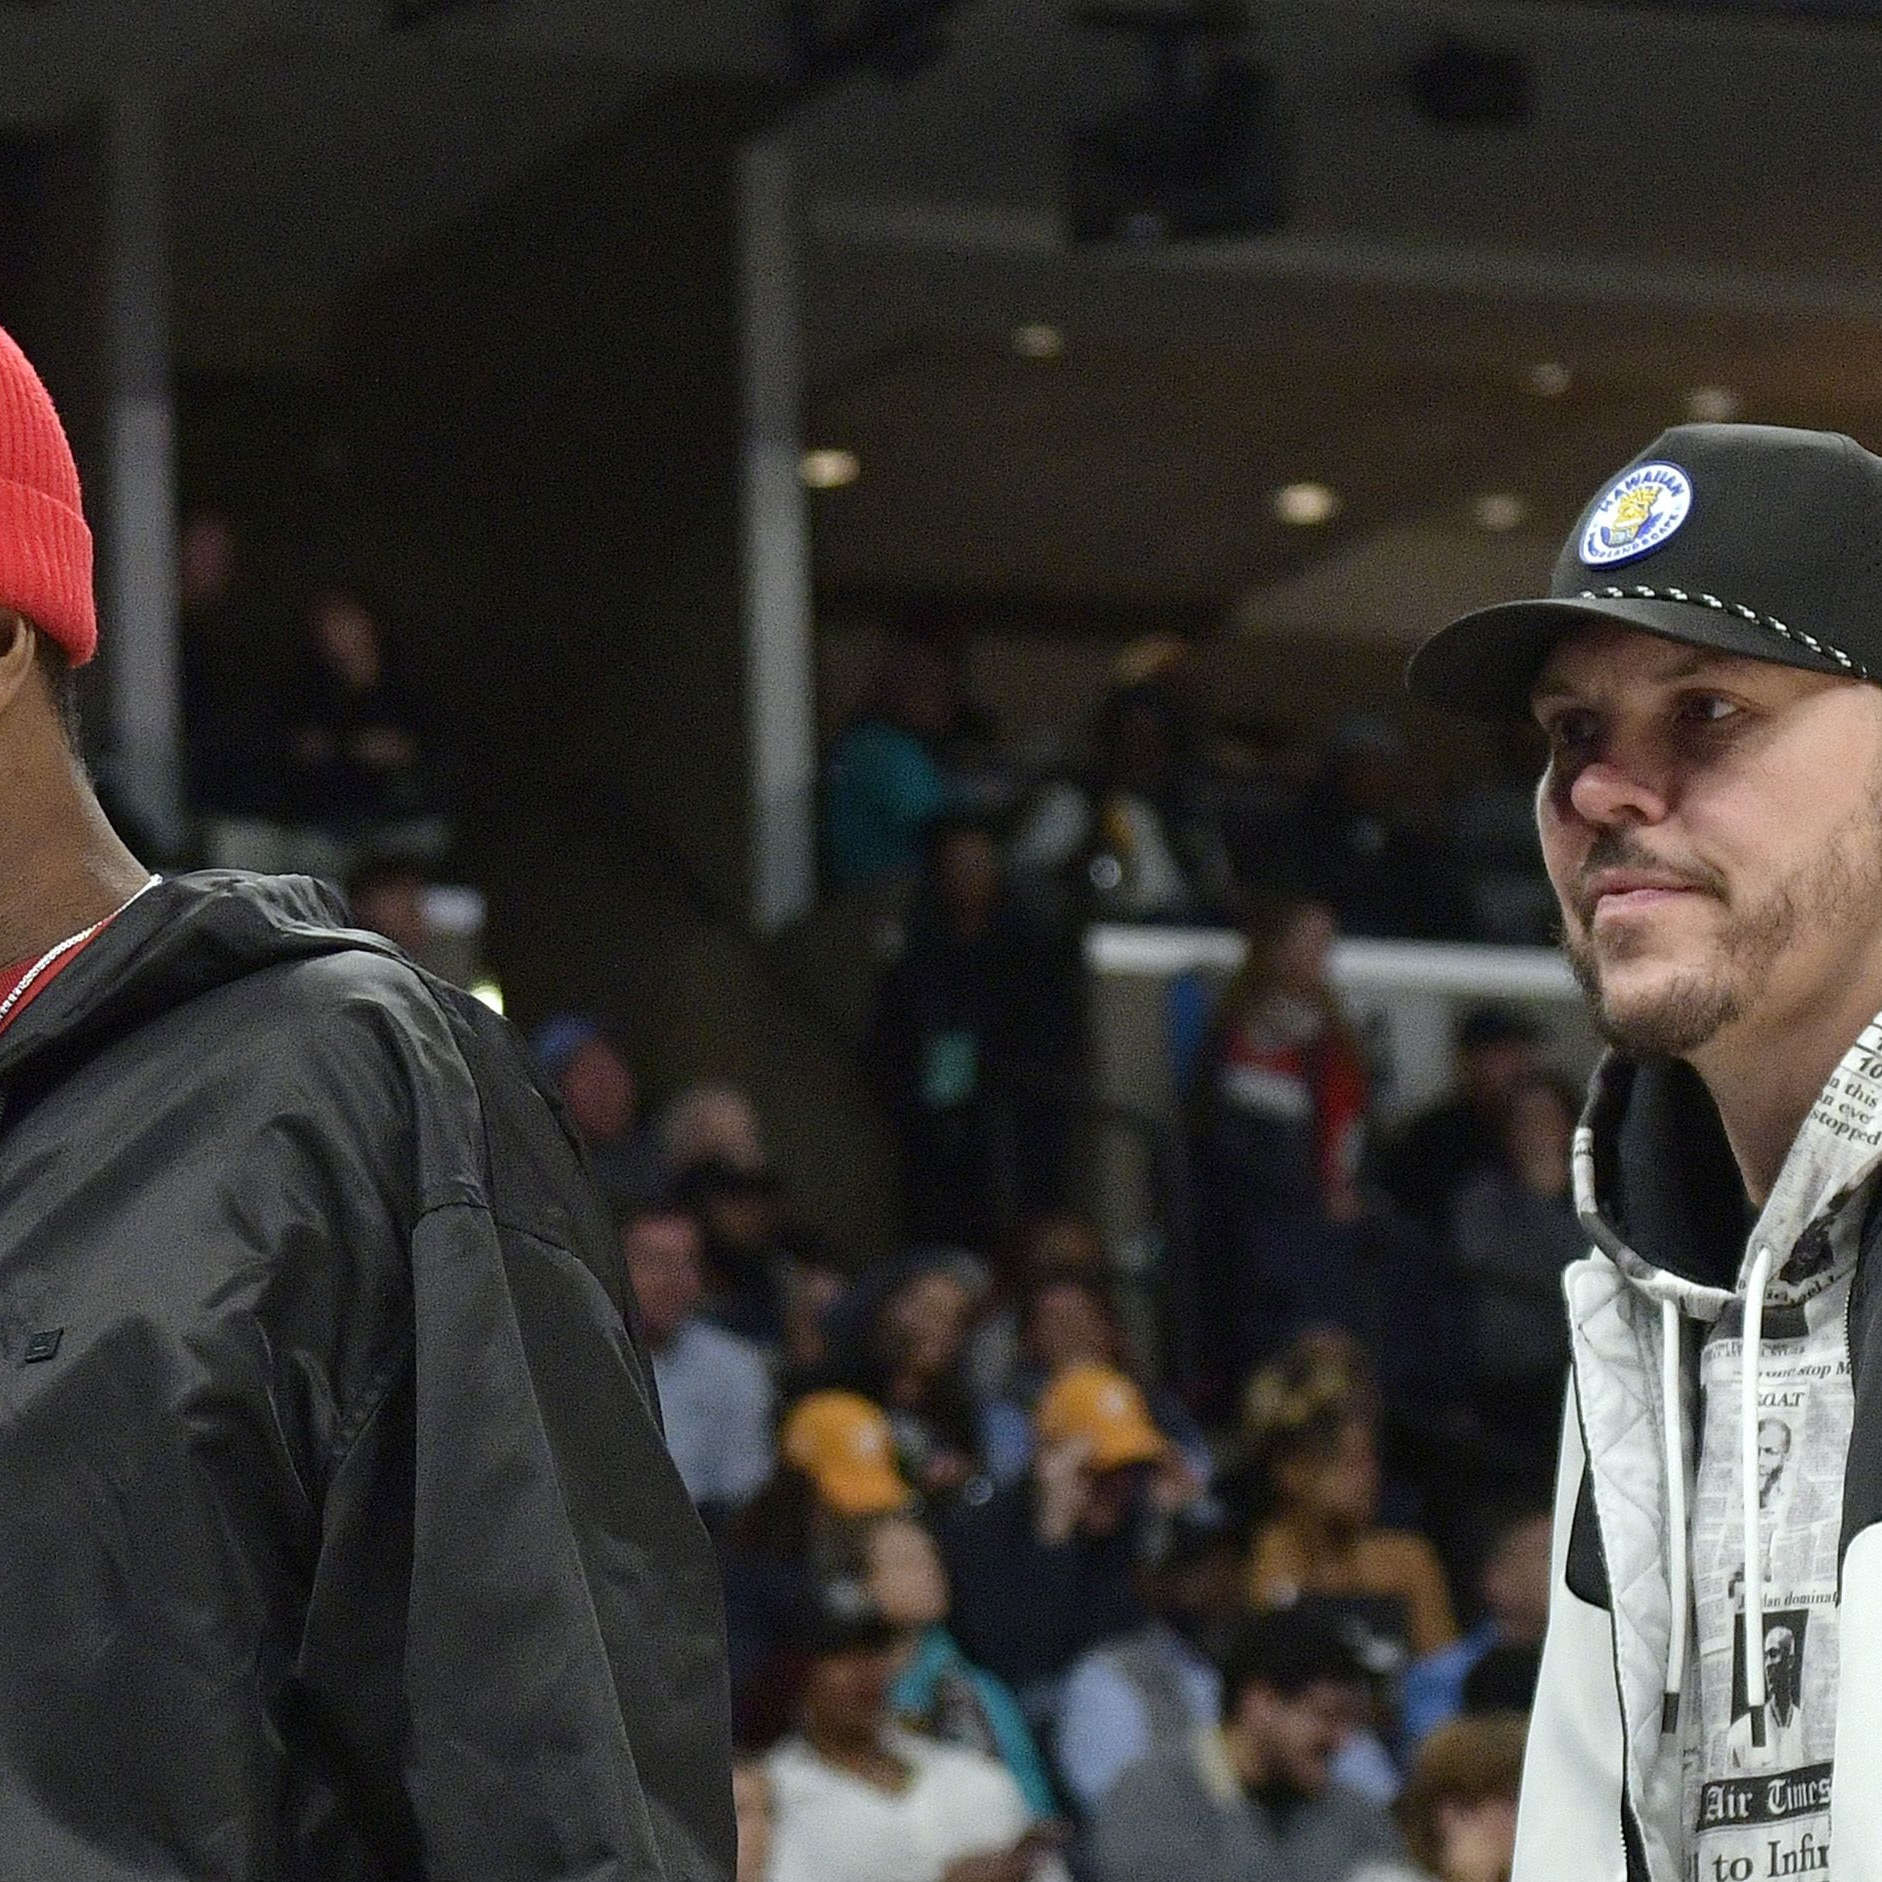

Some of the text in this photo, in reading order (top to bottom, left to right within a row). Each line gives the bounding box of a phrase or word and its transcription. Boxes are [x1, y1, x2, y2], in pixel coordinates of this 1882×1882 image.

[1598, 469, 1684, 512] HAWAIIAN
[1845, 1083, 1878, 1109] this
[1705, 1778, 1831, 1821] Air Times
